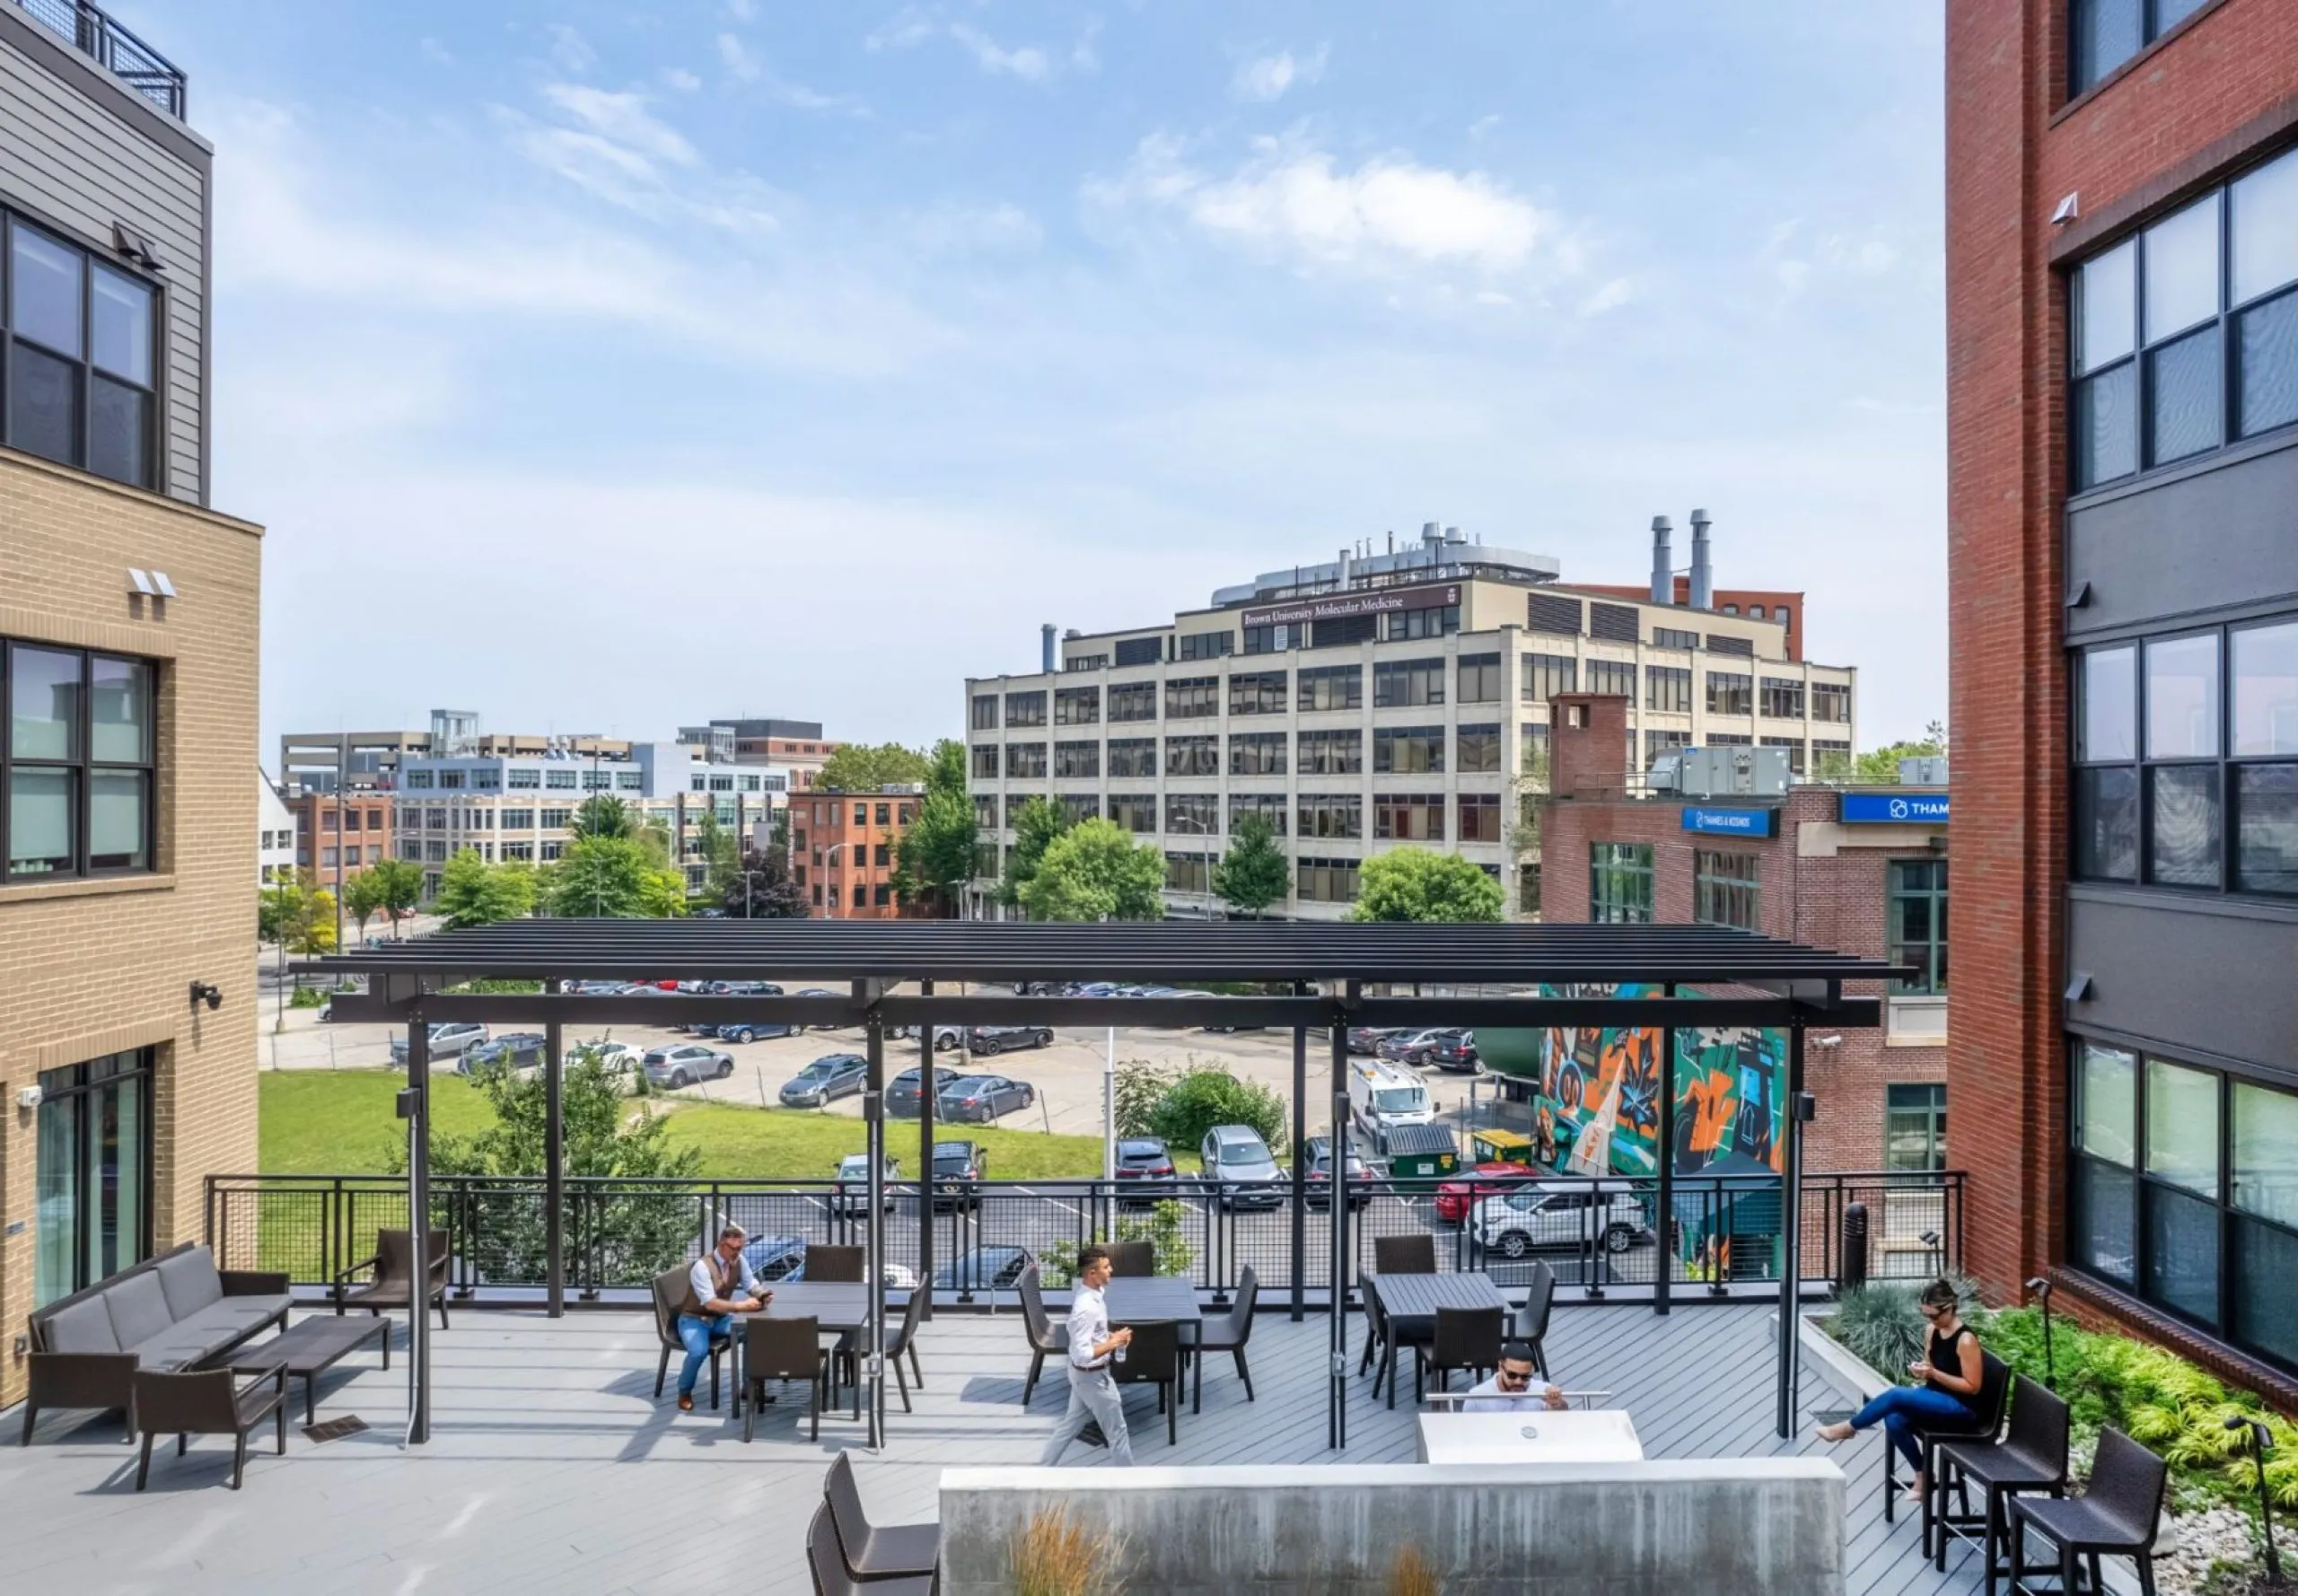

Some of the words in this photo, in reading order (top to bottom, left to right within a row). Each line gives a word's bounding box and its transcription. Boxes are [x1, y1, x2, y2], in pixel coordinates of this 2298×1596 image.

[1244, 614, 1271, 625] Brown
[1273, 610, 1312, 621] University
[1315, 602, 1359, 616] Molecular
[1361, 596, 1403, 610] Medicine
[1704, 815, 1723, 826] THAMES
